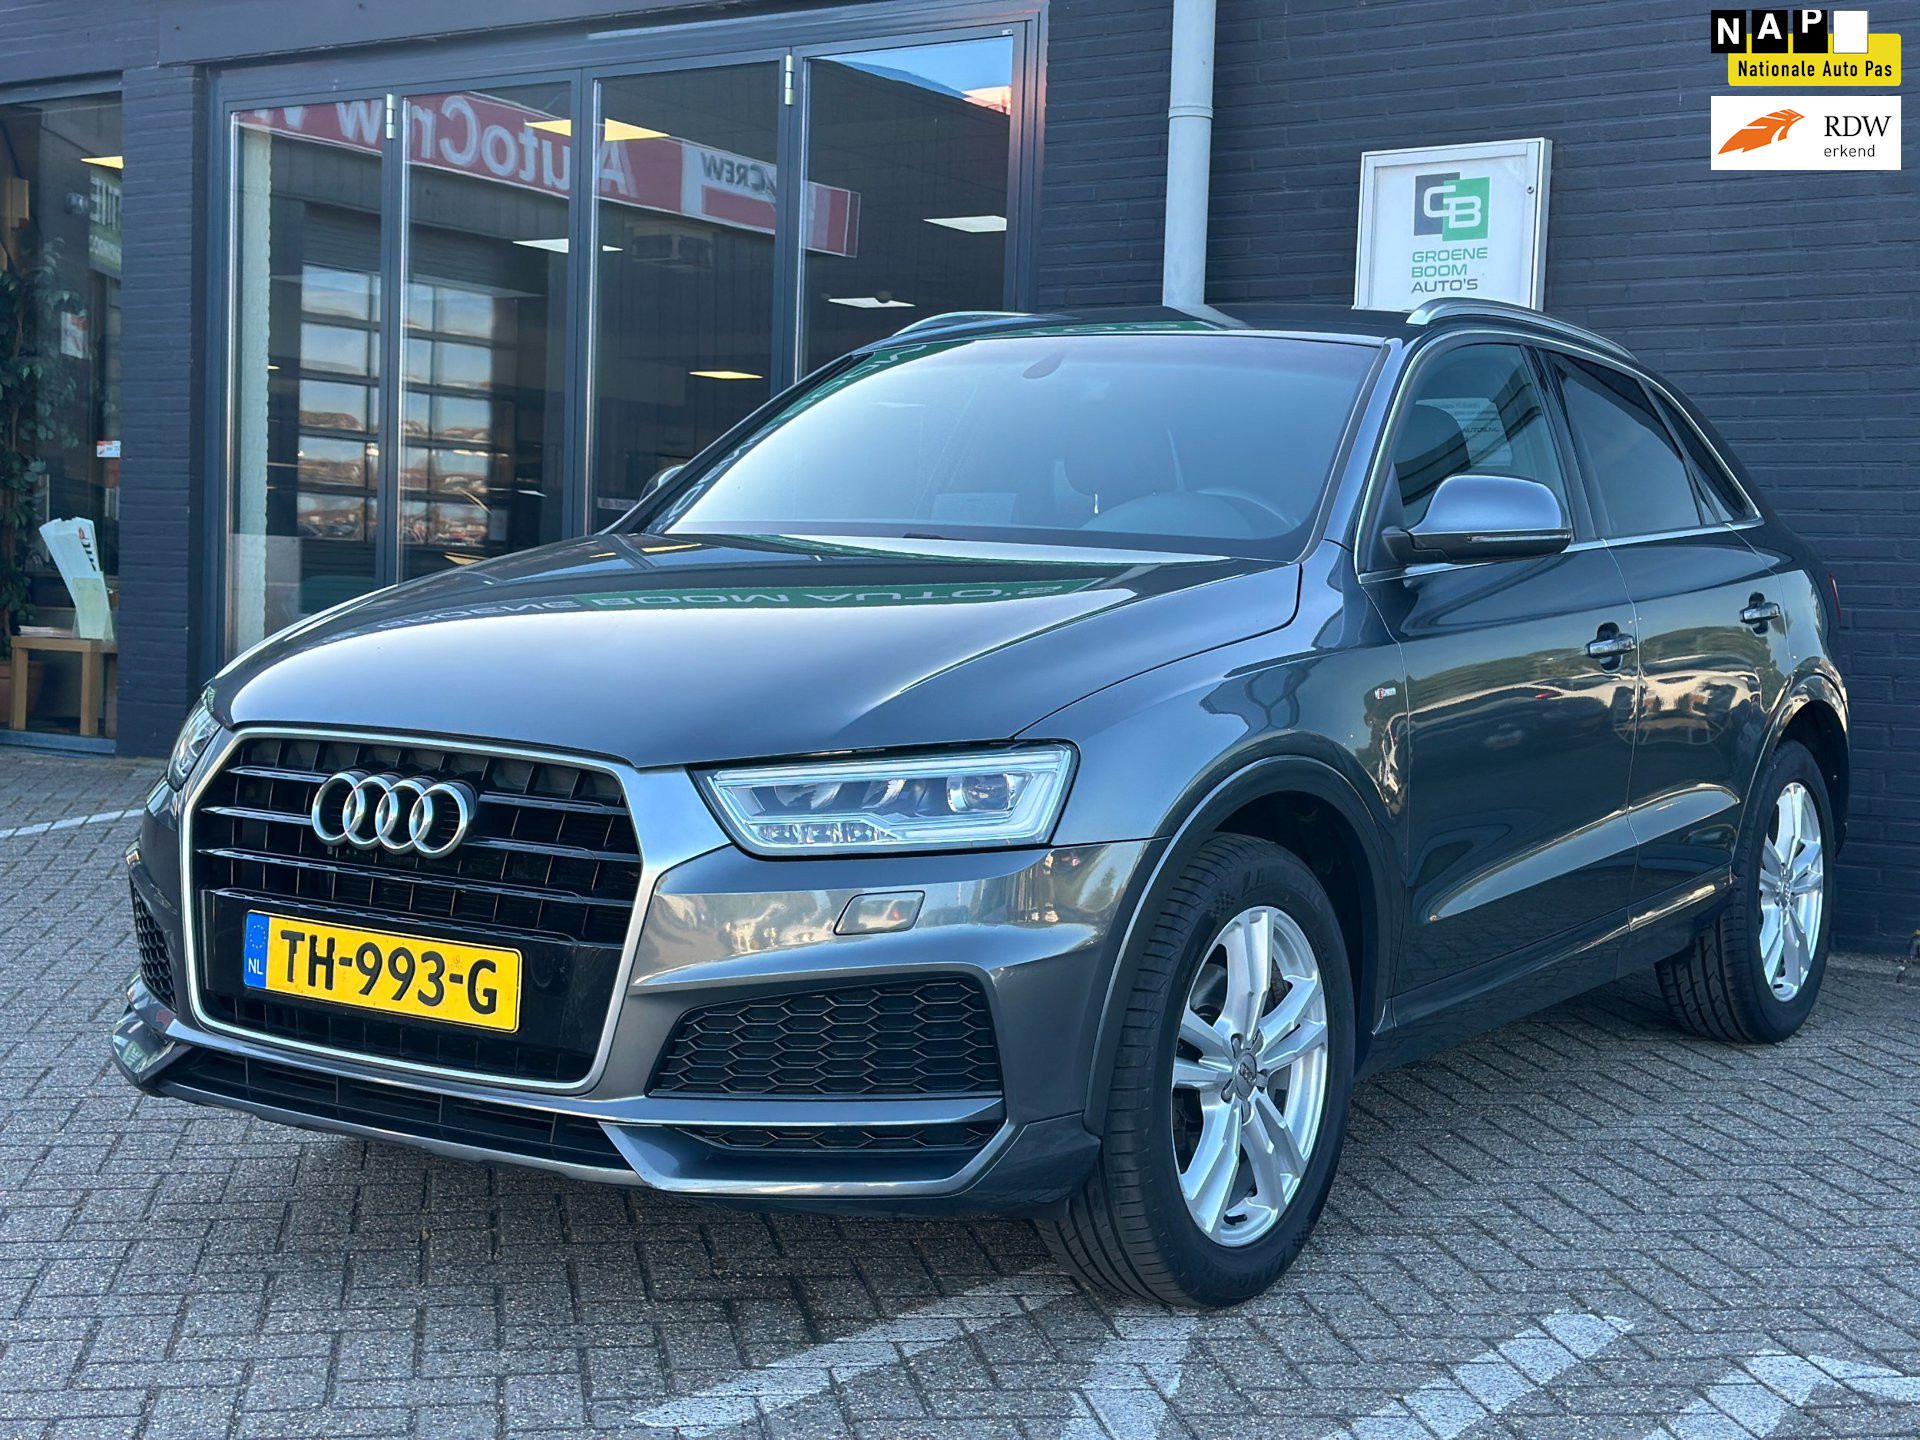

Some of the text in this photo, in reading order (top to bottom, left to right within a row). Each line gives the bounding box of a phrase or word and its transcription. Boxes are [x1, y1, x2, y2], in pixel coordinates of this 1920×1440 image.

[1412, 247, 1489, 263] GROENE
[1411, 264, 1468, 278] BOOM
[1411, 279, 1479, 294] AUTO'S
[247, 956, 264, 976] NL
[280, 929, 498, 1015] TH-993-G
